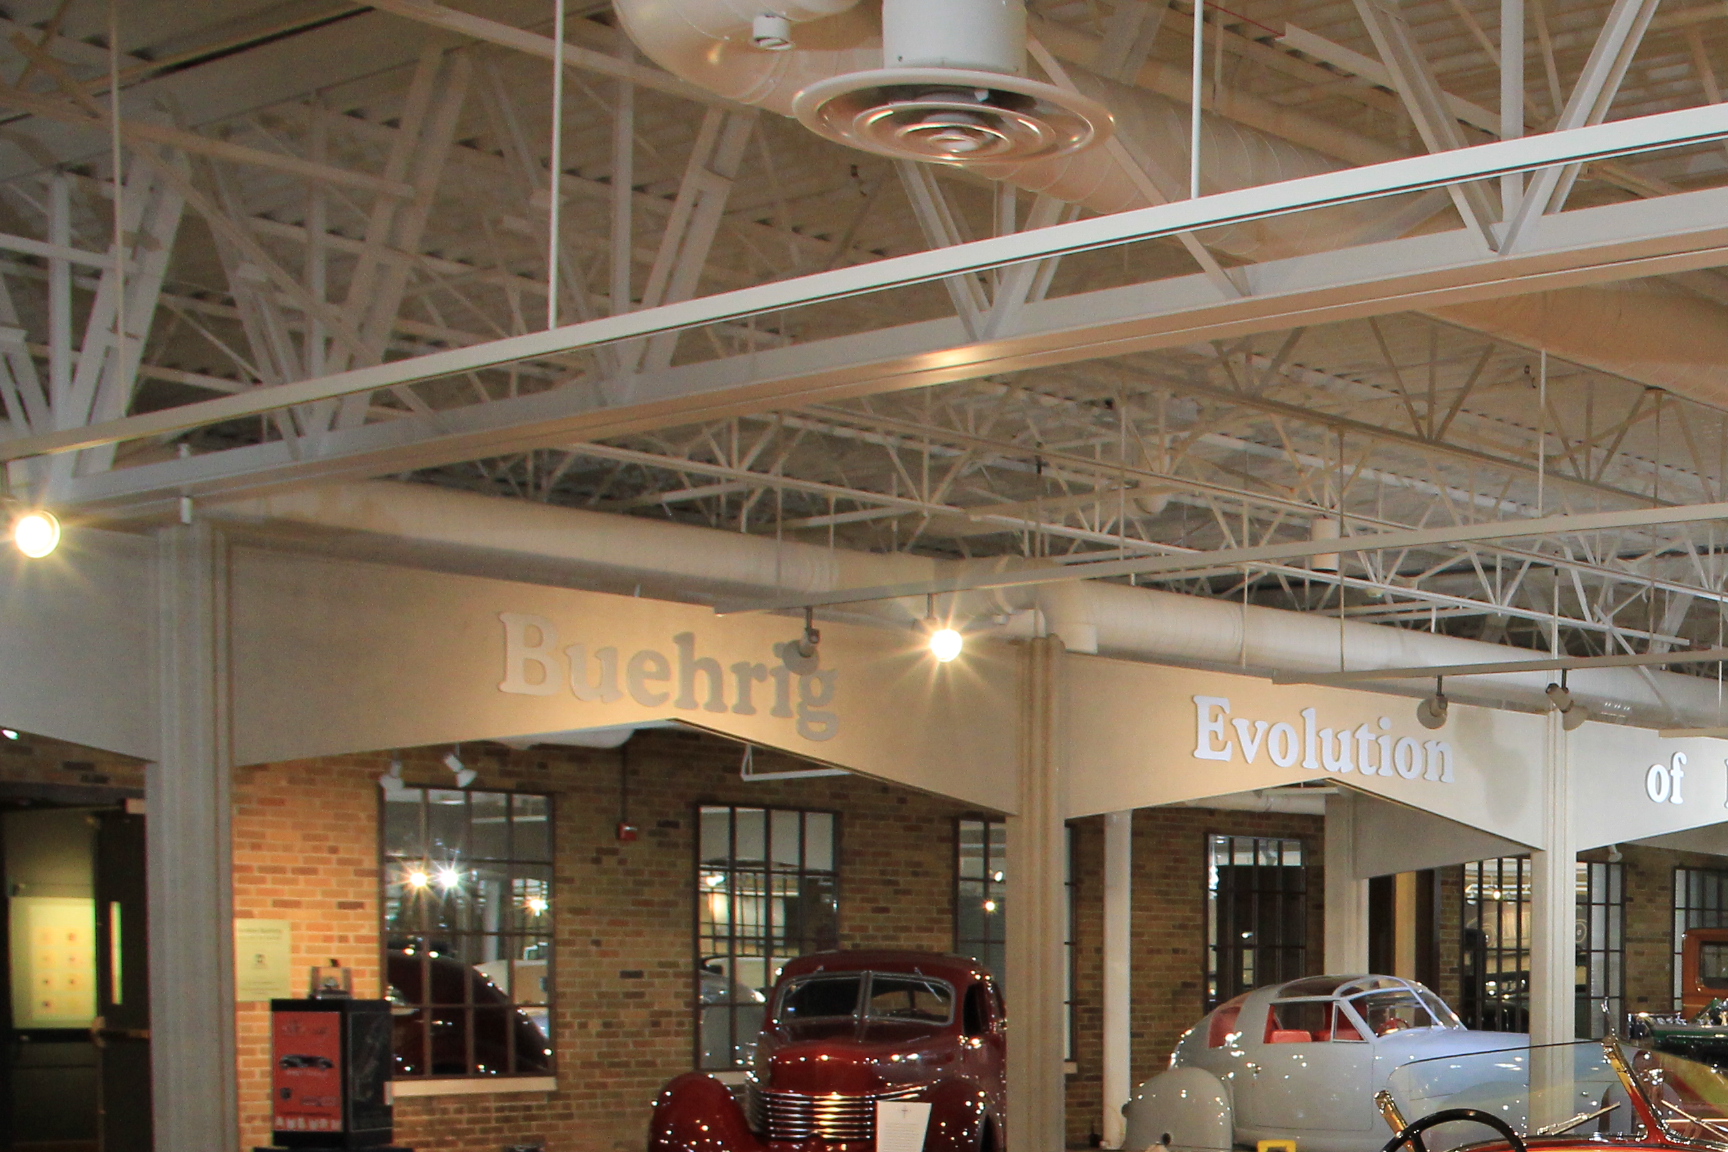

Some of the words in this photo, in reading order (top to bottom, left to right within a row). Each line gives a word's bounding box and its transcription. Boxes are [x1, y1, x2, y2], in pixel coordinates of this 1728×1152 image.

[498, 611, 840, 742] Buehrig
[1192, 694, 1455, 783] Evolution
[1646, 751, 1688, 804] of
